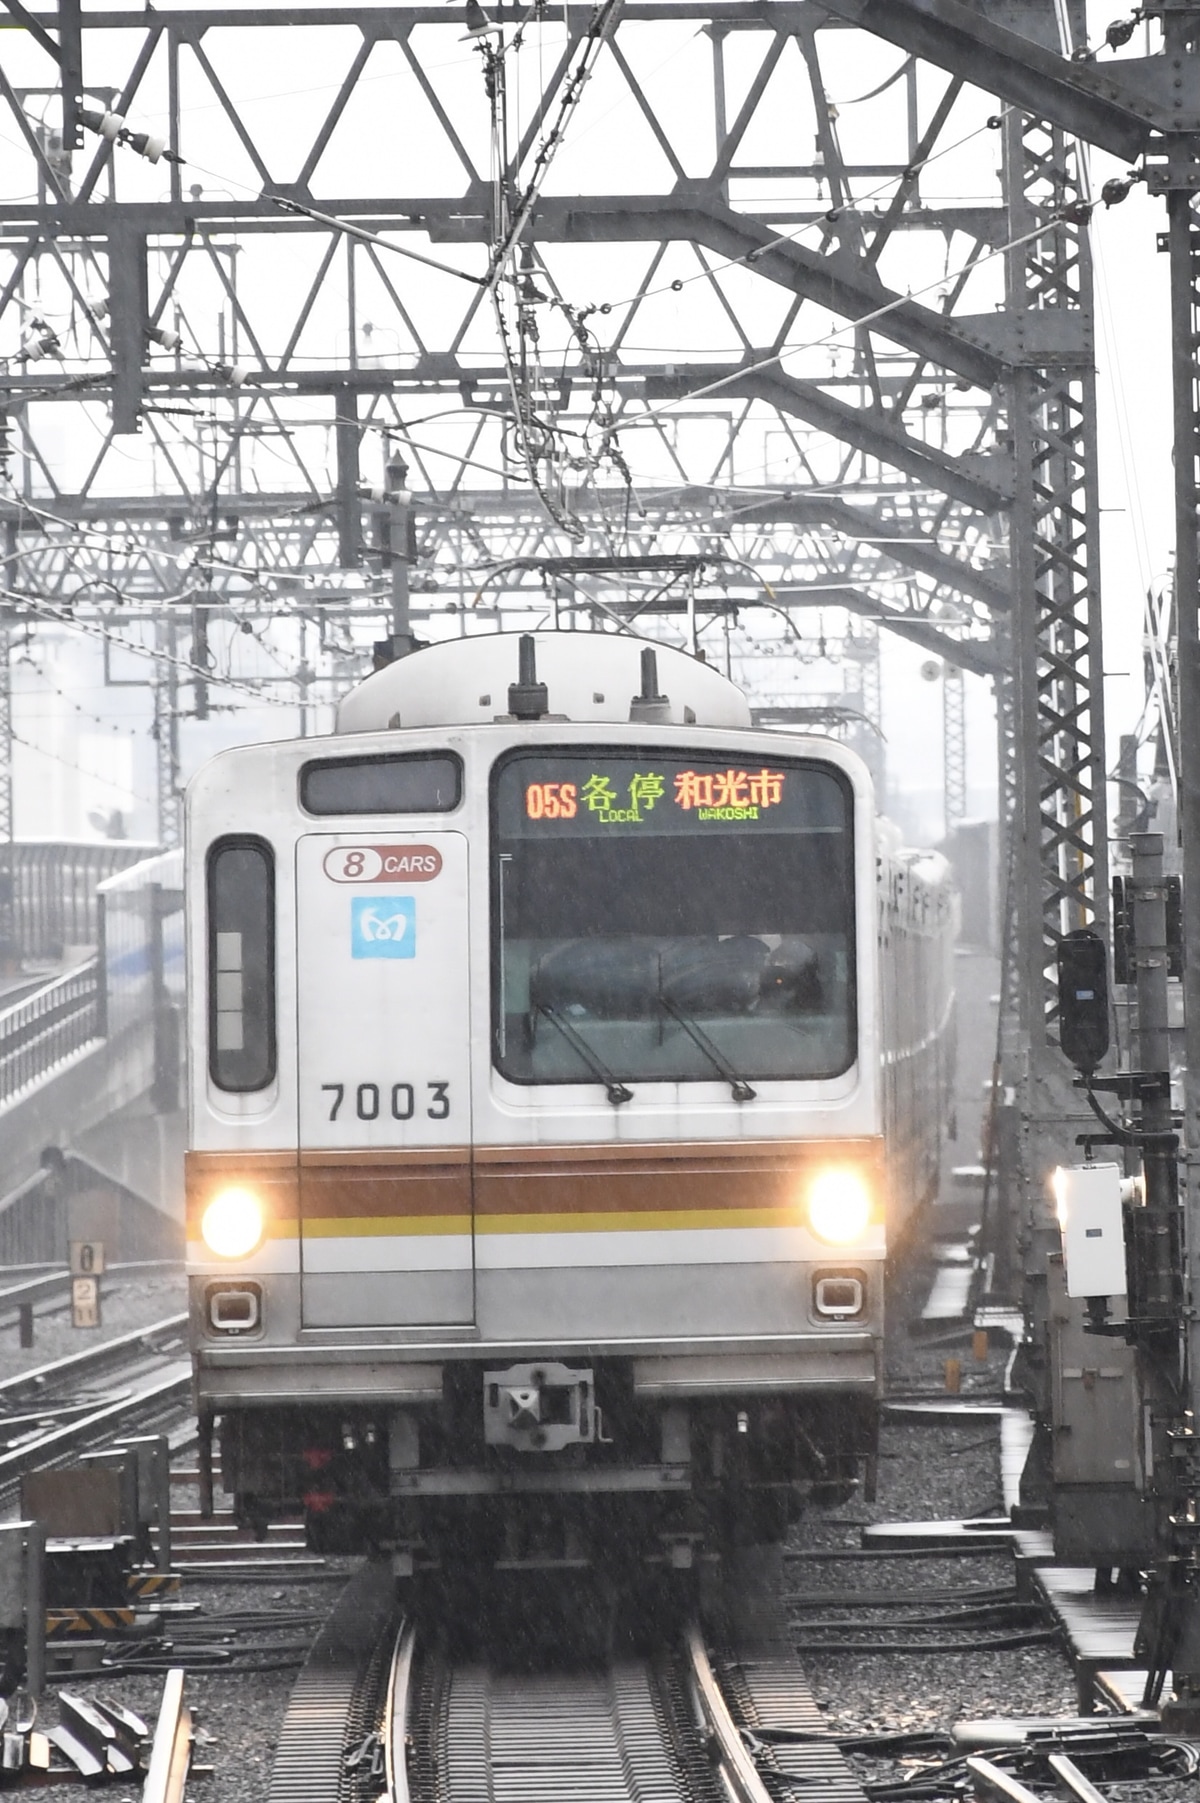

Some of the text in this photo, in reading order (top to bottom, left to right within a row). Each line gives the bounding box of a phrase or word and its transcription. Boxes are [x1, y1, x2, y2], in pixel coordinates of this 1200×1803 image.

[526, 783, 577, 820] 05S
[673, 769, 785, 810] 和光市
[599, 806, 759, 823] LOCAL WAKOSHI
[342, 851, 436, 878] 8 CARS
[321, 1081, 451, 1121] 7003
